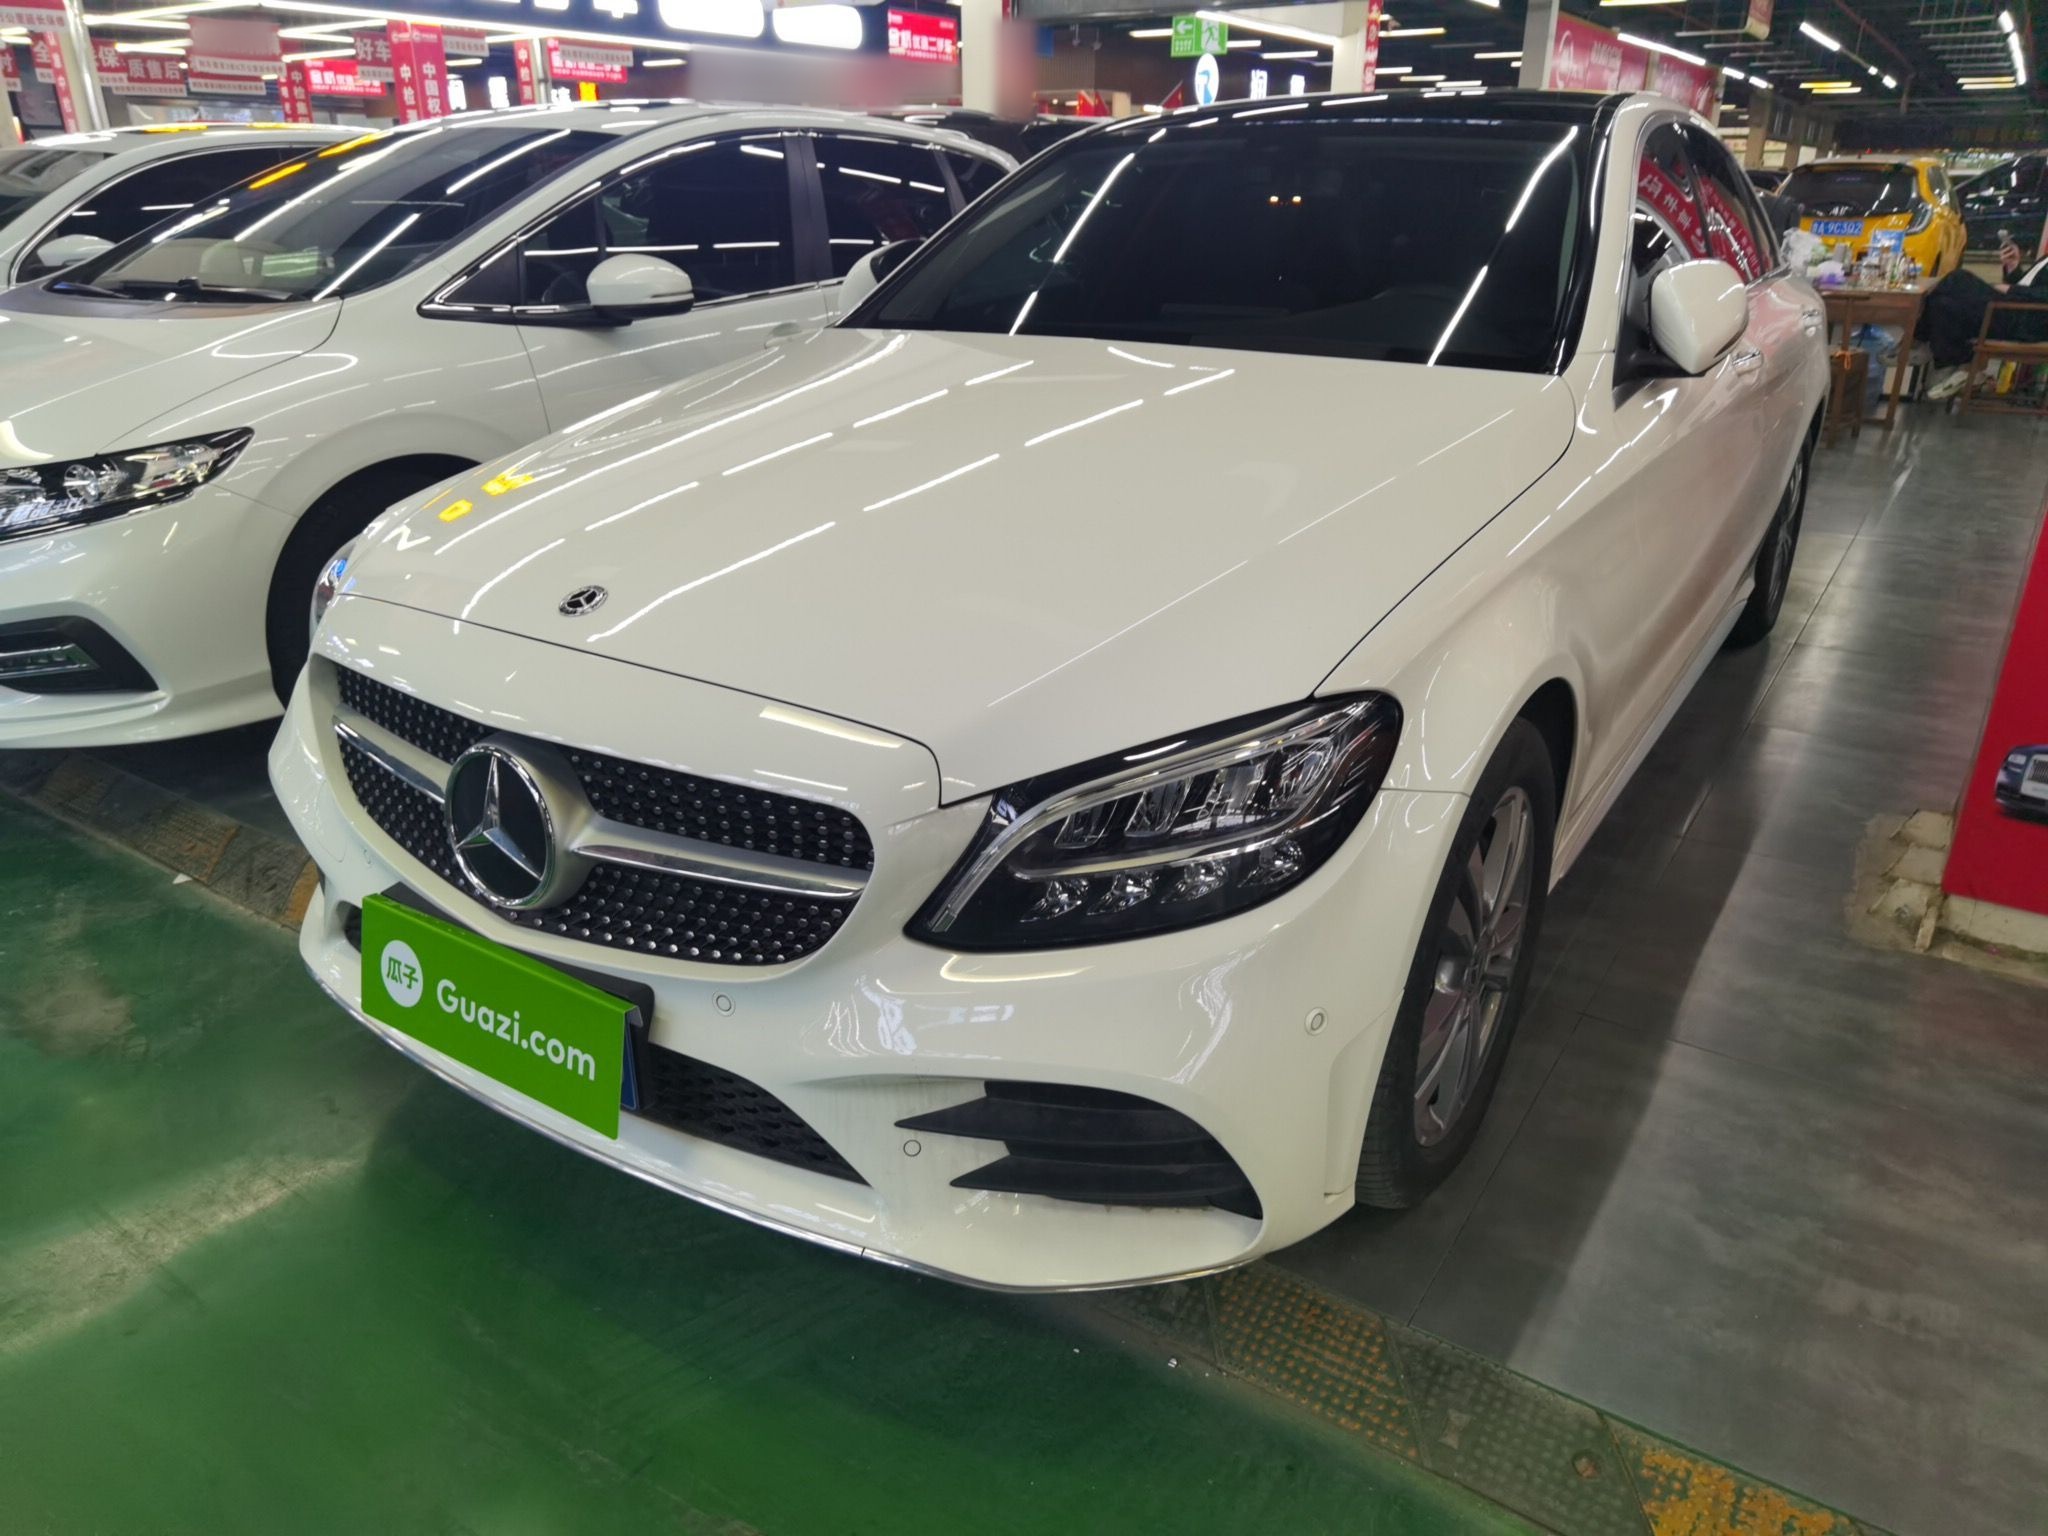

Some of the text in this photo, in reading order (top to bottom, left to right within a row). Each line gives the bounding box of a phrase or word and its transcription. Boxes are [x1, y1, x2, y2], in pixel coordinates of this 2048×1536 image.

[422, 62, 442, 118] 中国权
[386, 956, 419, 990] 瓜子
[437, 978, 596, 1081] Guazi.com
